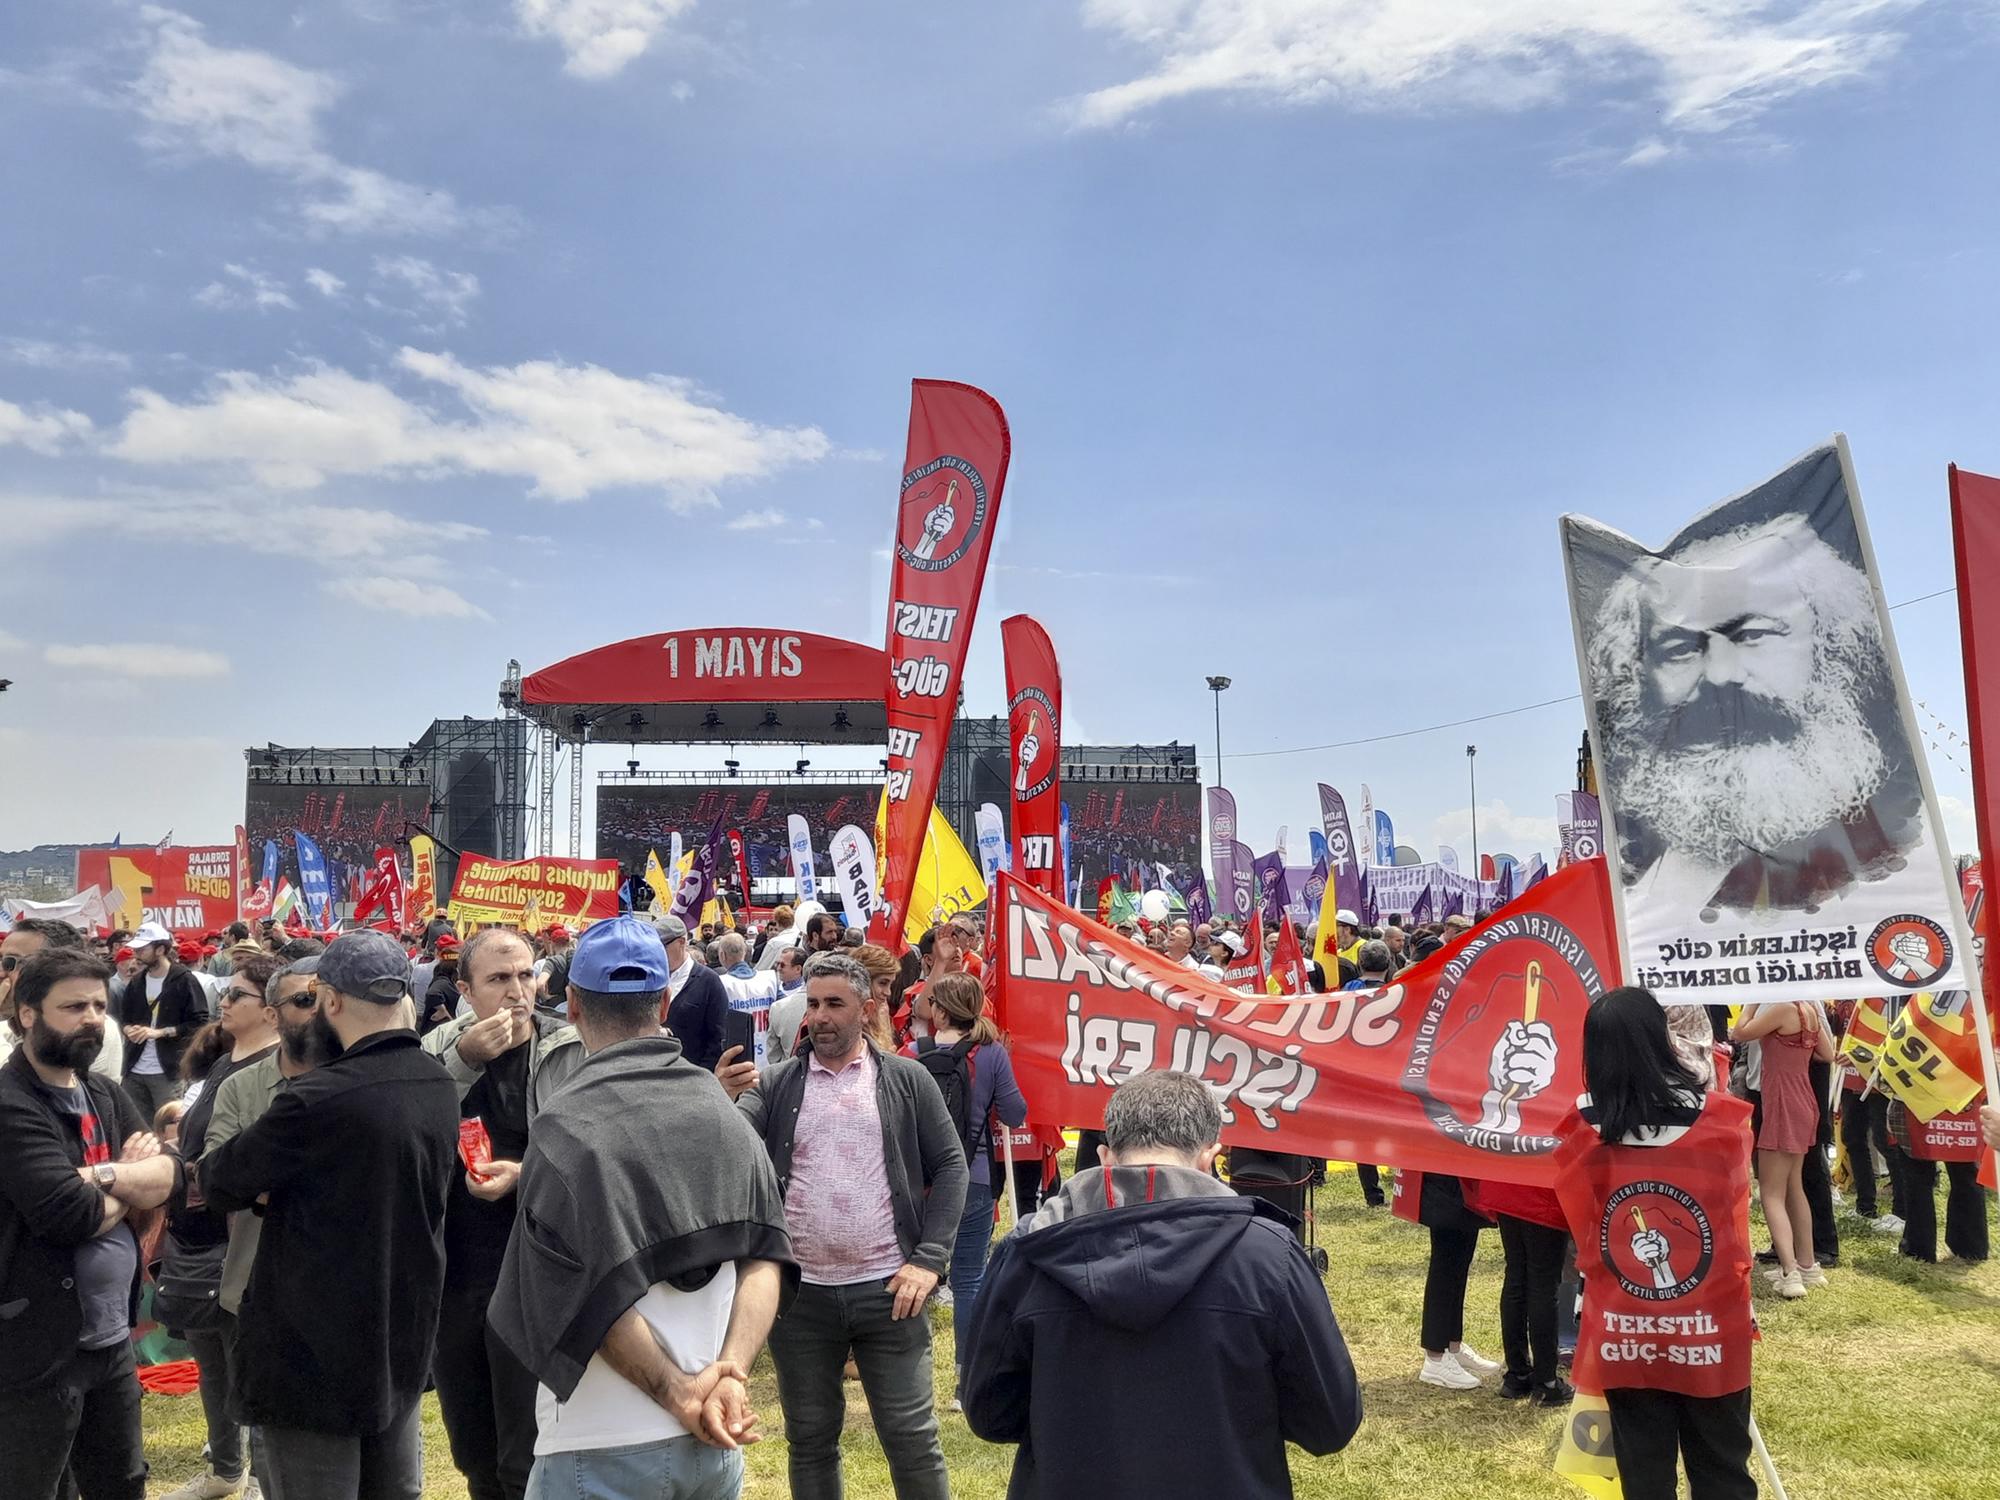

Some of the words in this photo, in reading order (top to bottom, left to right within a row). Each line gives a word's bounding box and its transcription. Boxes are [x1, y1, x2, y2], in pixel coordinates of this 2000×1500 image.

[663, 637, 679, 679] 1
[694, 635, 804, 679] MAYIS
[1925, 1132, 1977, 1148] GÜÇ-SEN
[1637, 1181, 1656, 1194] GÜÇ
[1658, 1276, 1700, 1300] GÜÇ-SEN
[1603, 1310, 1719, 1336] TEKSTİL
[1600, 1338, 1723, 1366] GÜÇ-SEN
